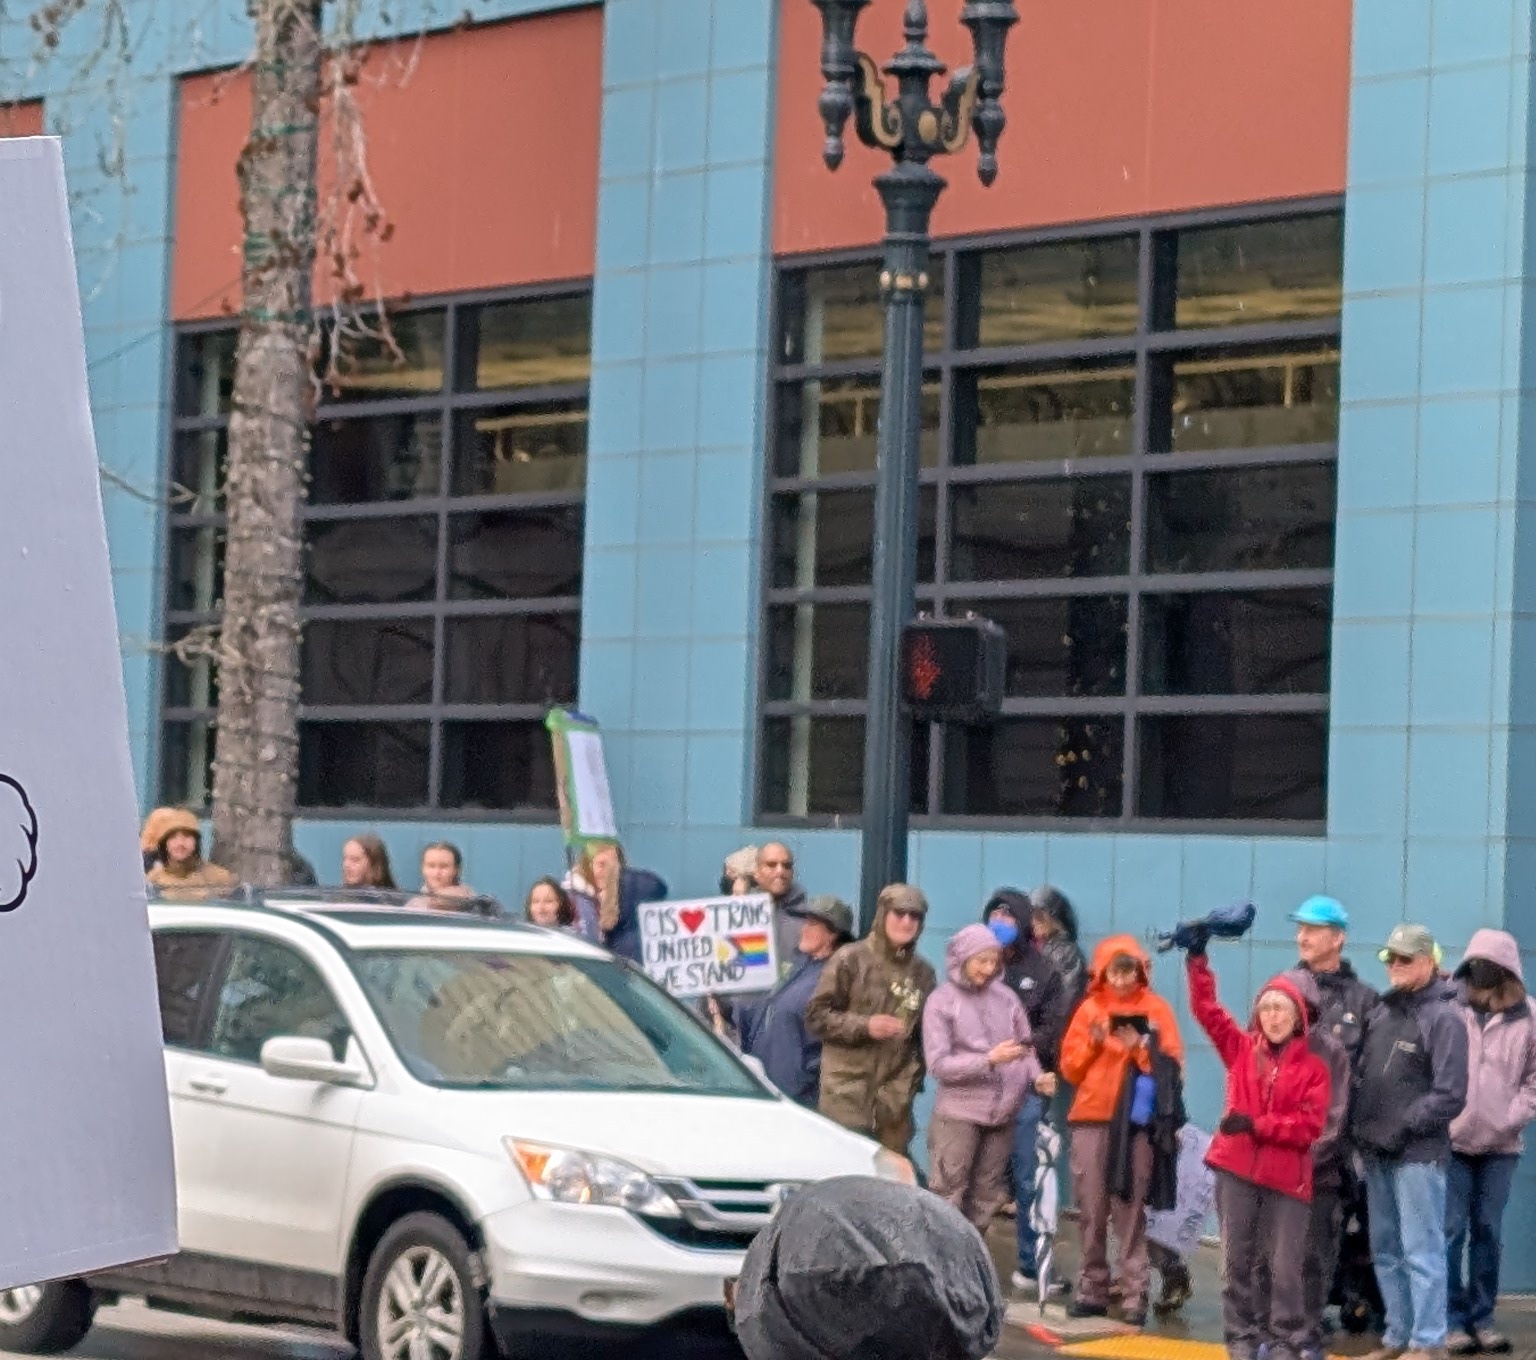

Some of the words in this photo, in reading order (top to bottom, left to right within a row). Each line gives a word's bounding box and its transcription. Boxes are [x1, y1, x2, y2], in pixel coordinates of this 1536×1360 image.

[644, 907, 678, 937] CIS
[704, 900, 771, 933] TRANS
[645, 935, 713, 964] UNITED
[686, 960, 746, 989] STAND
